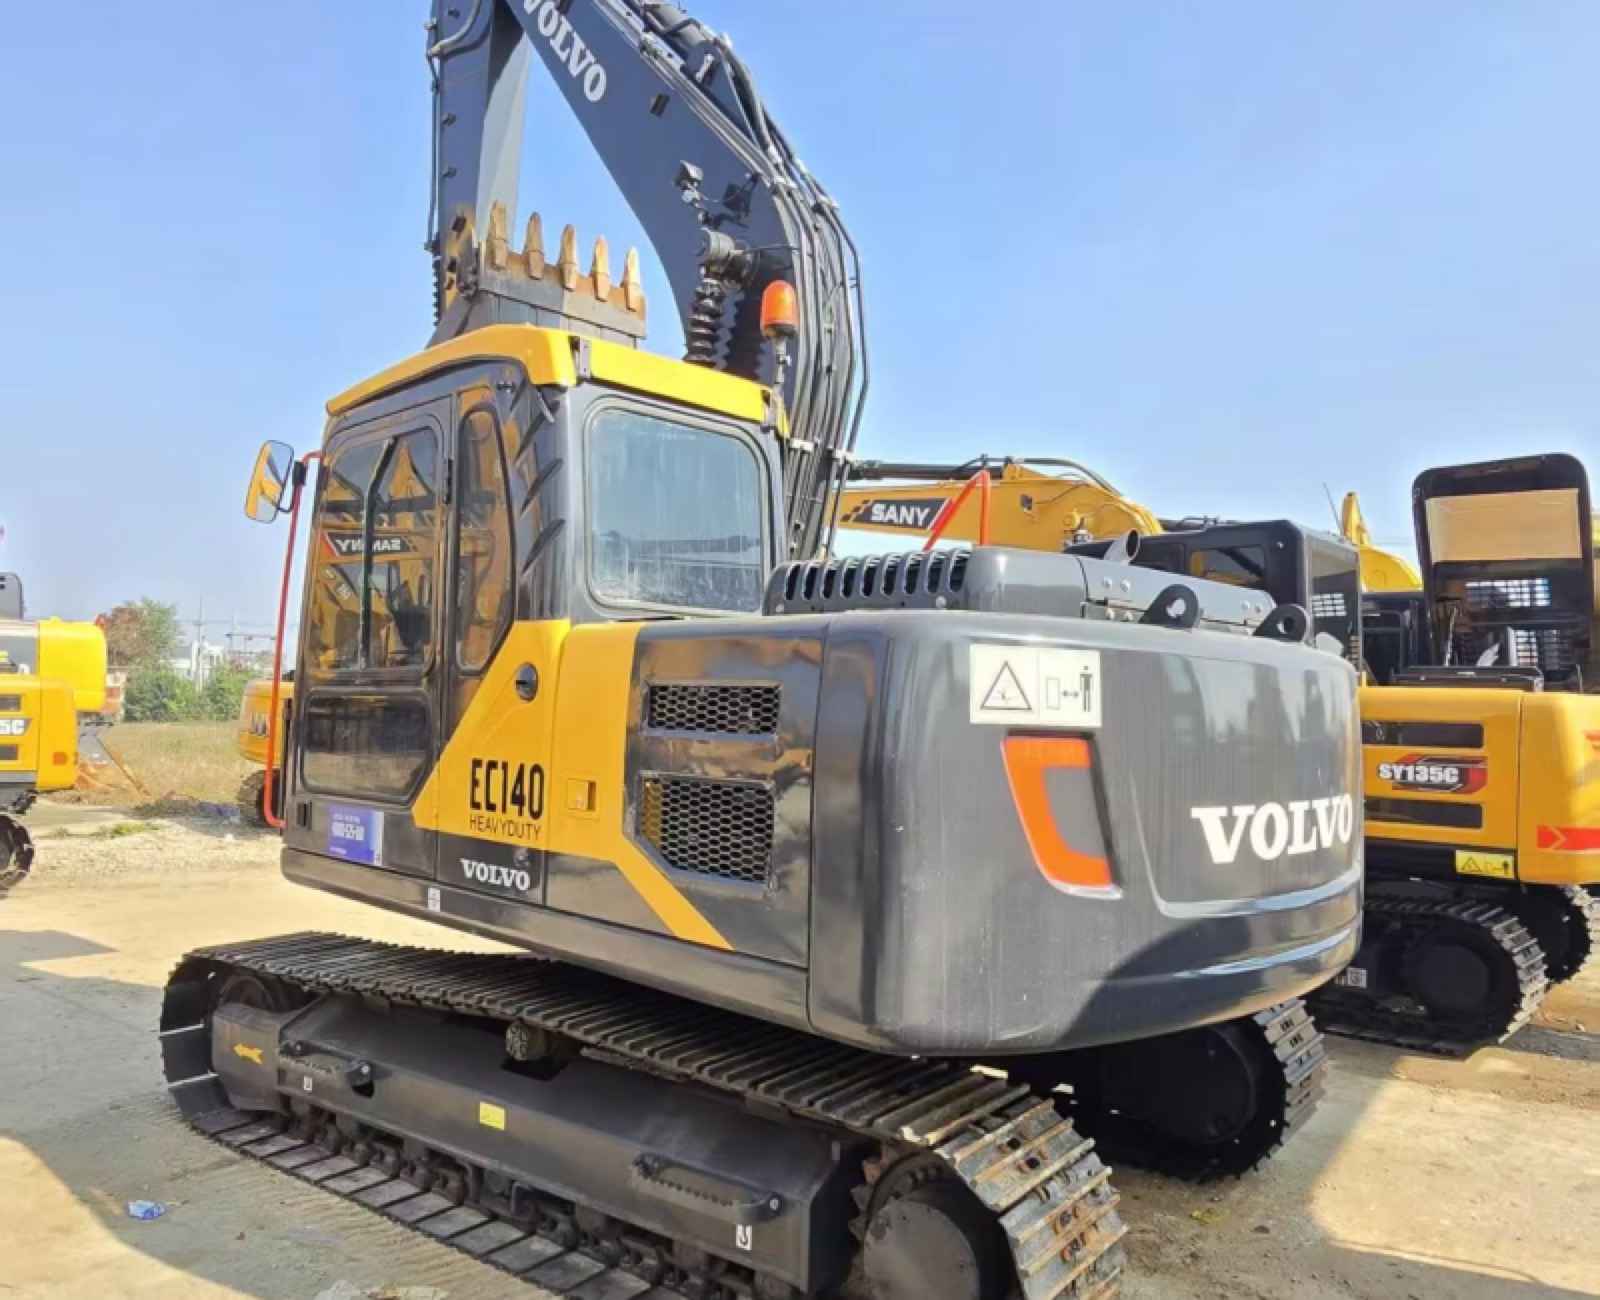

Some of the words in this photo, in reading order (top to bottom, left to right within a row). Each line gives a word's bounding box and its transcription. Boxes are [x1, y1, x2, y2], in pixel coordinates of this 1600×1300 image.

[870, 503, 930, 526] SANY
[1378, 763, 1459, 783] SY135C
[470, 758, 545, 820] EC140
[469, 815, 541, 840] HEAVYDUTY
[1190, 793, 1353, 864] VOLVO
[460, 858, 530, 890] VOLVO
